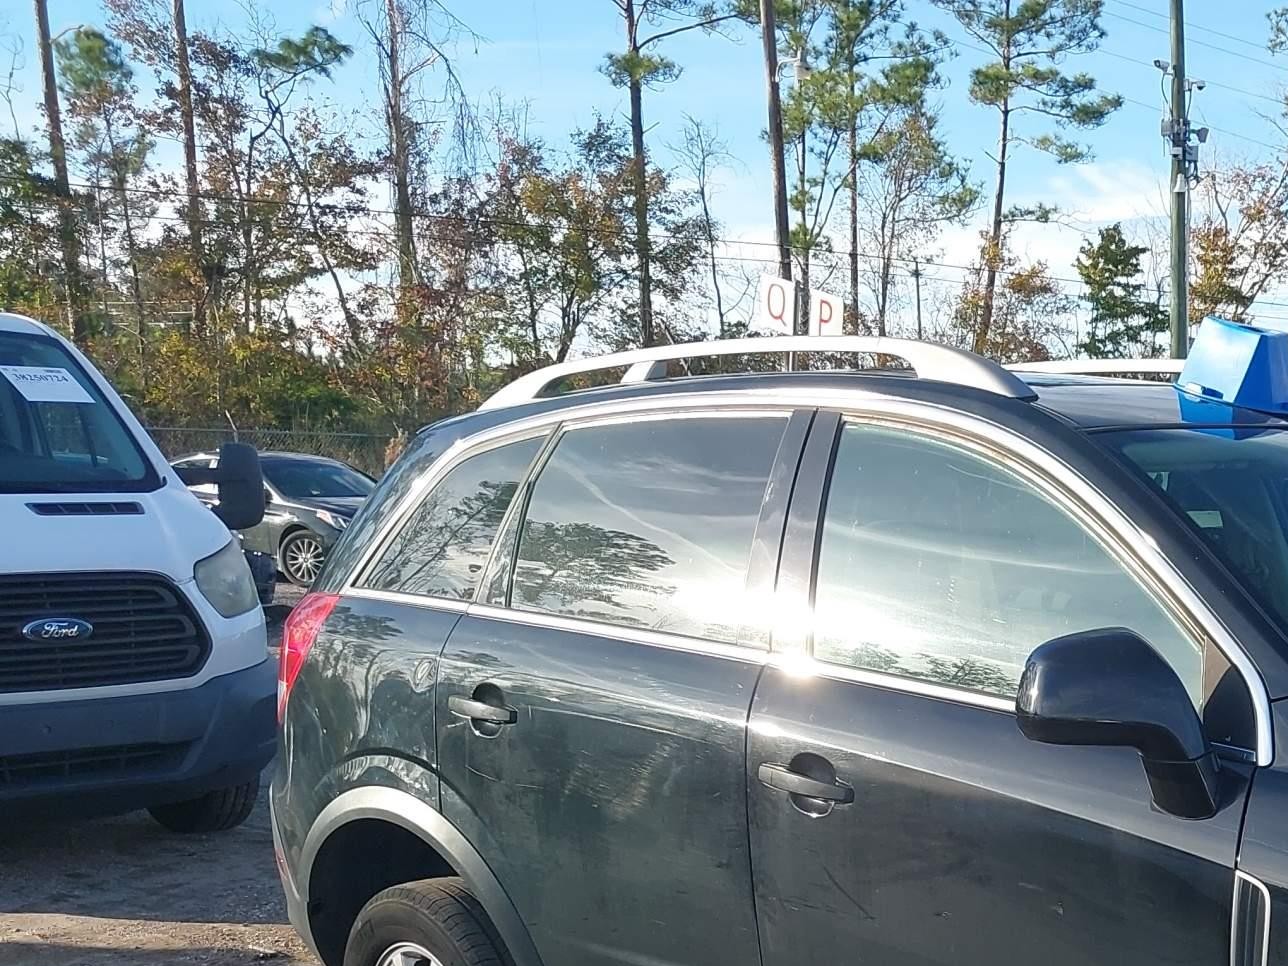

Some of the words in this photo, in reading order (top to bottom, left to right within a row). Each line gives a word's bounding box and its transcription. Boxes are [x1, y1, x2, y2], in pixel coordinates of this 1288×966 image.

[767, 283, 787, 326] Q
[818, 298, 833, 336] P
[41, 622, 79, 638] Ford
